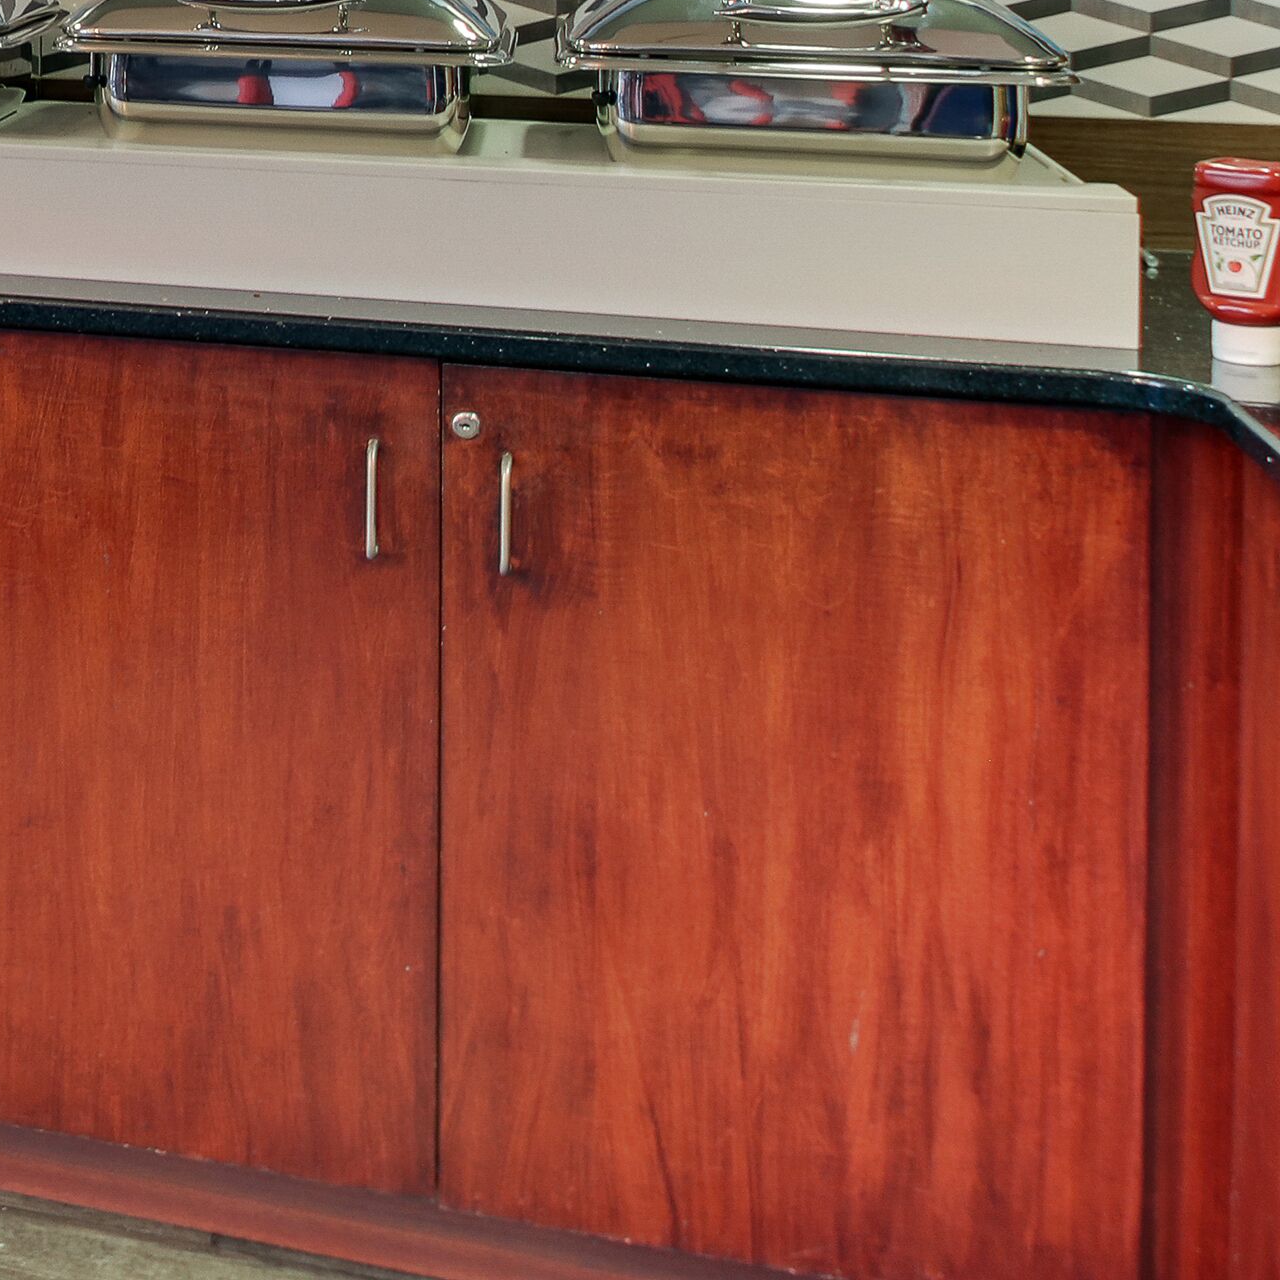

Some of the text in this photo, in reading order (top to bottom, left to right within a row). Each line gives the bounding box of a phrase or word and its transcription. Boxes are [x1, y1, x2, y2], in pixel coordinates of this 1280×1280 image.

[1216, 205, 1255, 219] HEINZ
[1211, 223, 1263, 240] TOMATO
[1213, 237, 1260, 249] KETCHUP
